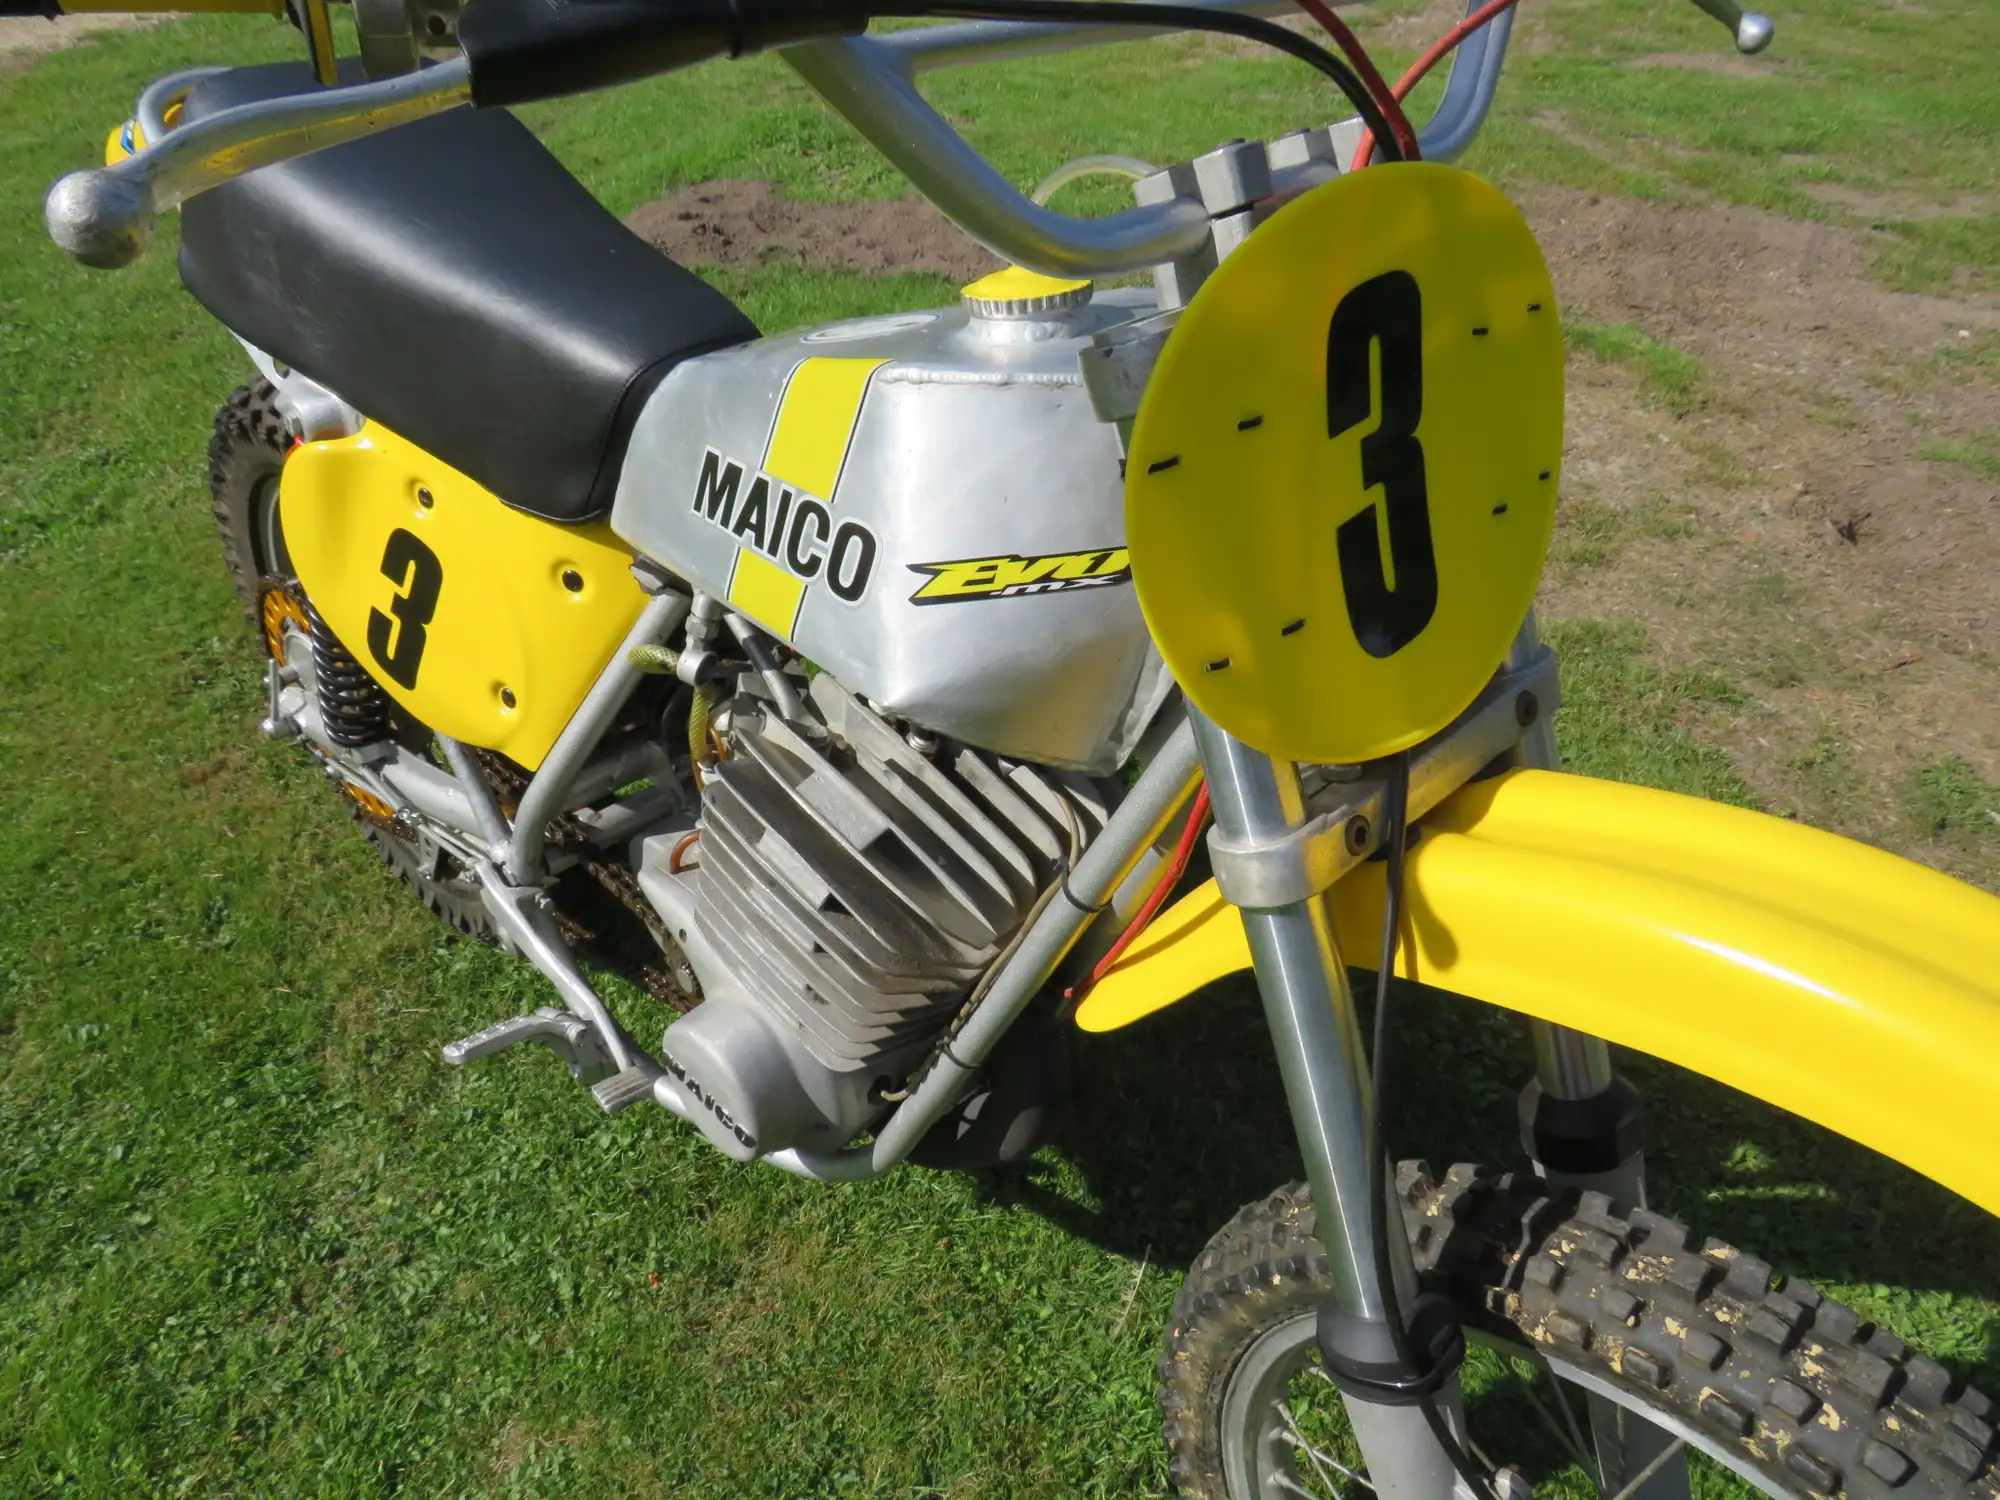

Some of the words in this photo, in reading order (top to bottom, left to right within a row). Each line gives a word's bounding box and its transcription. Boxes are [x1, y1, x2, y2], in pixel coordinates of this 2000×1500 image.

[693, 449, 878, 603] MAICO
[1327, 270, 1438, 658] 3
[367, 528, 443, 690] 3
